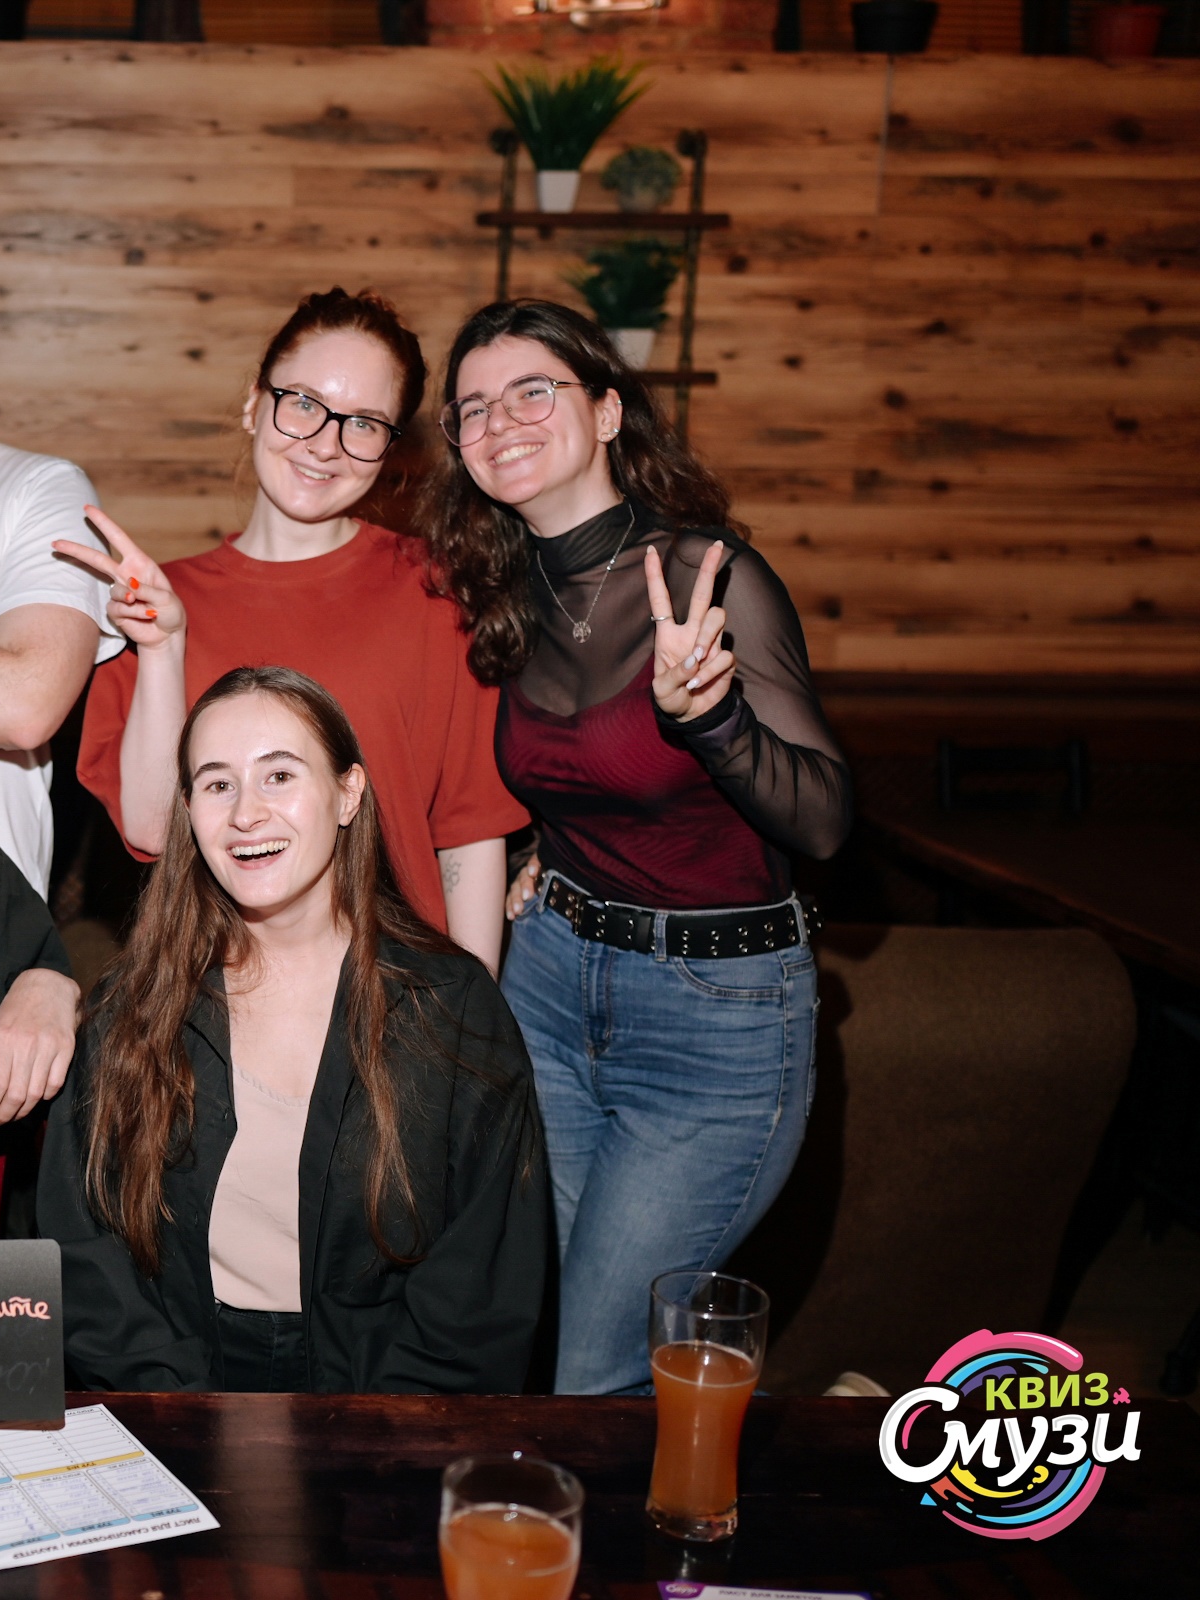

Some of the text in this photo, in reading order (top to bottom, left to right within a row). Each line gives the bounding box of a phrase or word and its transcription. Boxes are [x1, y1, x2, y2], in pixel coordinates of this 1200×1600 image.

[150, 1521, 171, 1532] ДЛЯ
[173, 1516, 201, 1527] ЛИСТ
[65, 1526, 149, 1548] САМОПРОВЕРКИ
